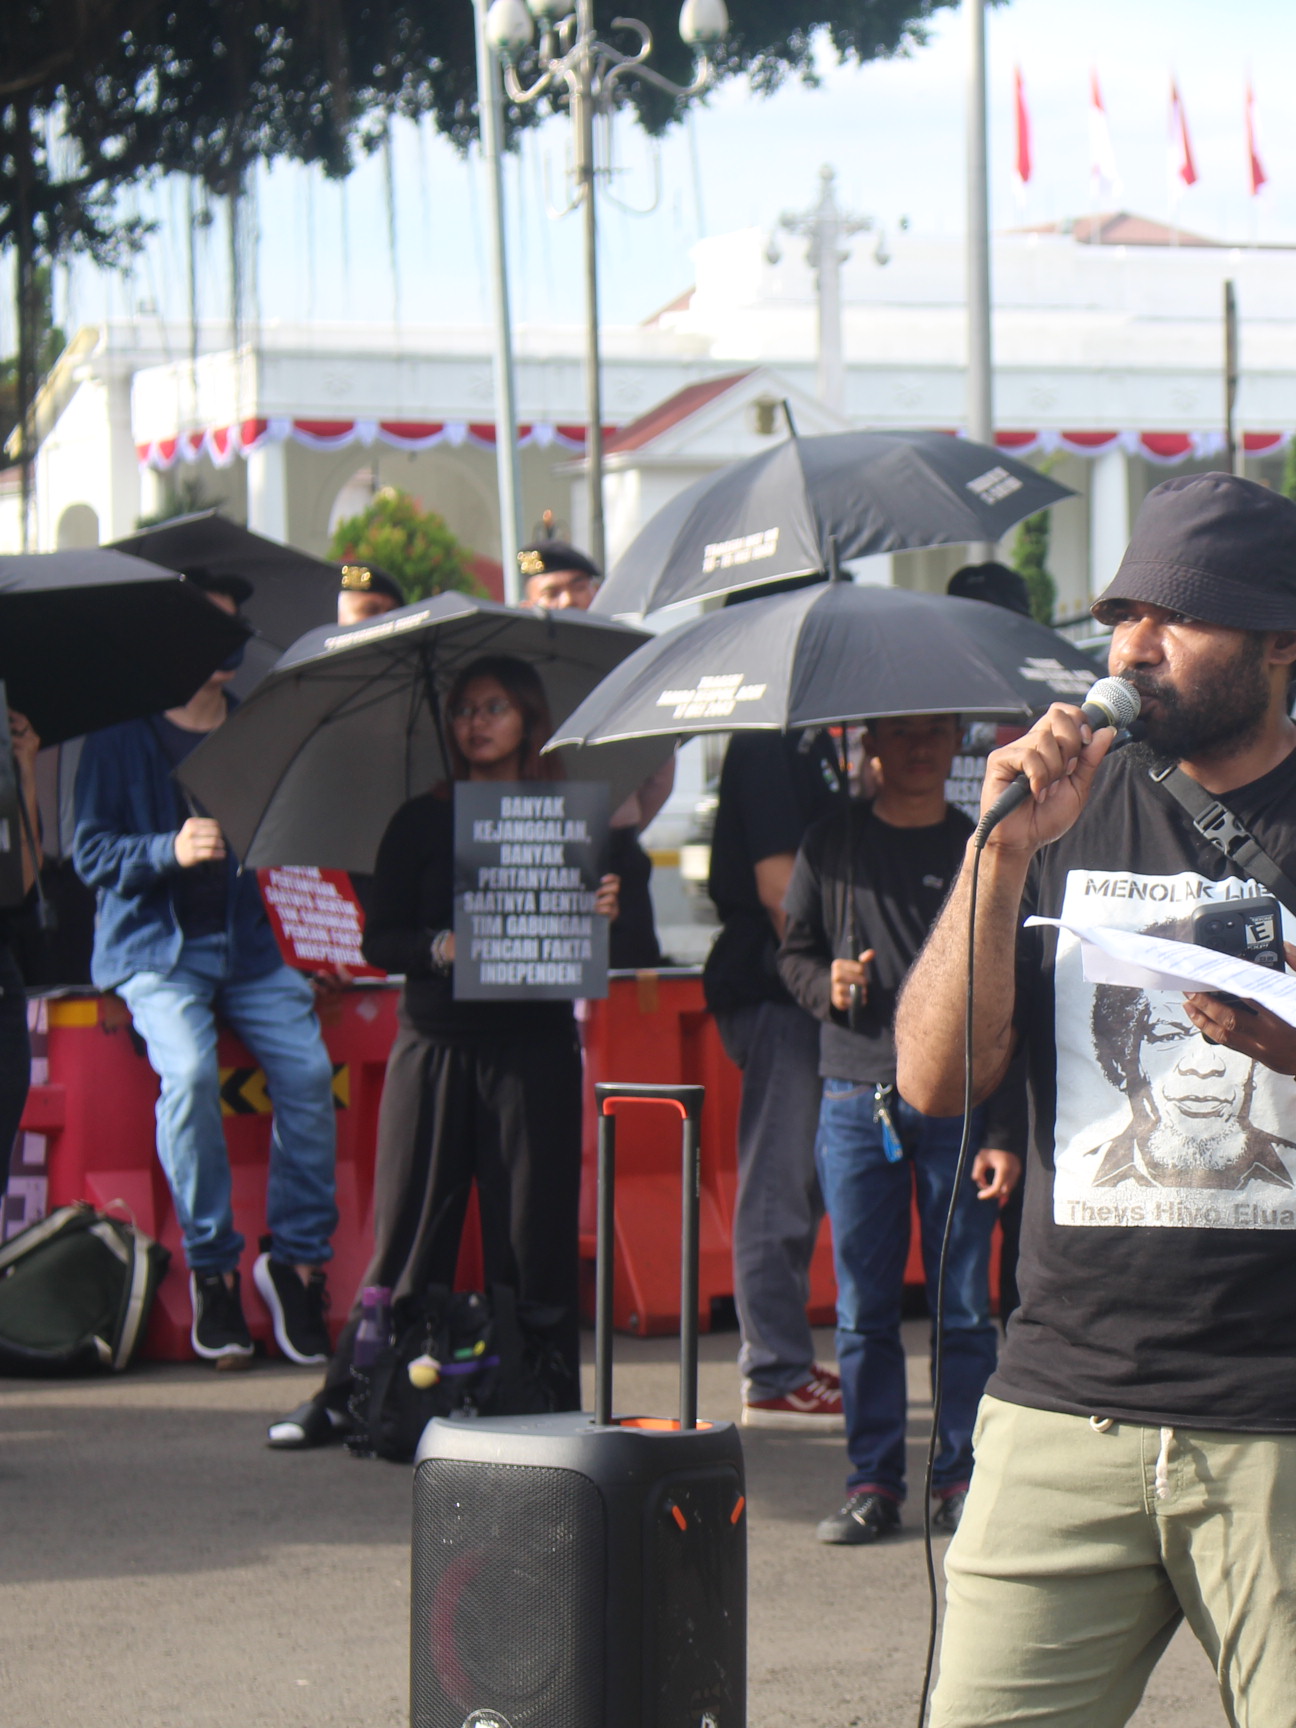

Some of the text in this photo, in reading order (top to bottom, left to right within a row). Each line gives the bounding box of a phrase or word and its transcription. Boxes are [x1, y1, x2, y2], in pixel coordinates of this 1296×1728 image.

[501, 796, 565, 818] BANYAK
[501, 844, 565, 866] BANYAK
[1084, 878, 1215, 902] MENOLAK
[464, 891, 537, 913] SAATNYA
[472, 915, 592, 936] TIM GABUNGAN
[471, 938, 592, 960] PENCARI FAKTA
